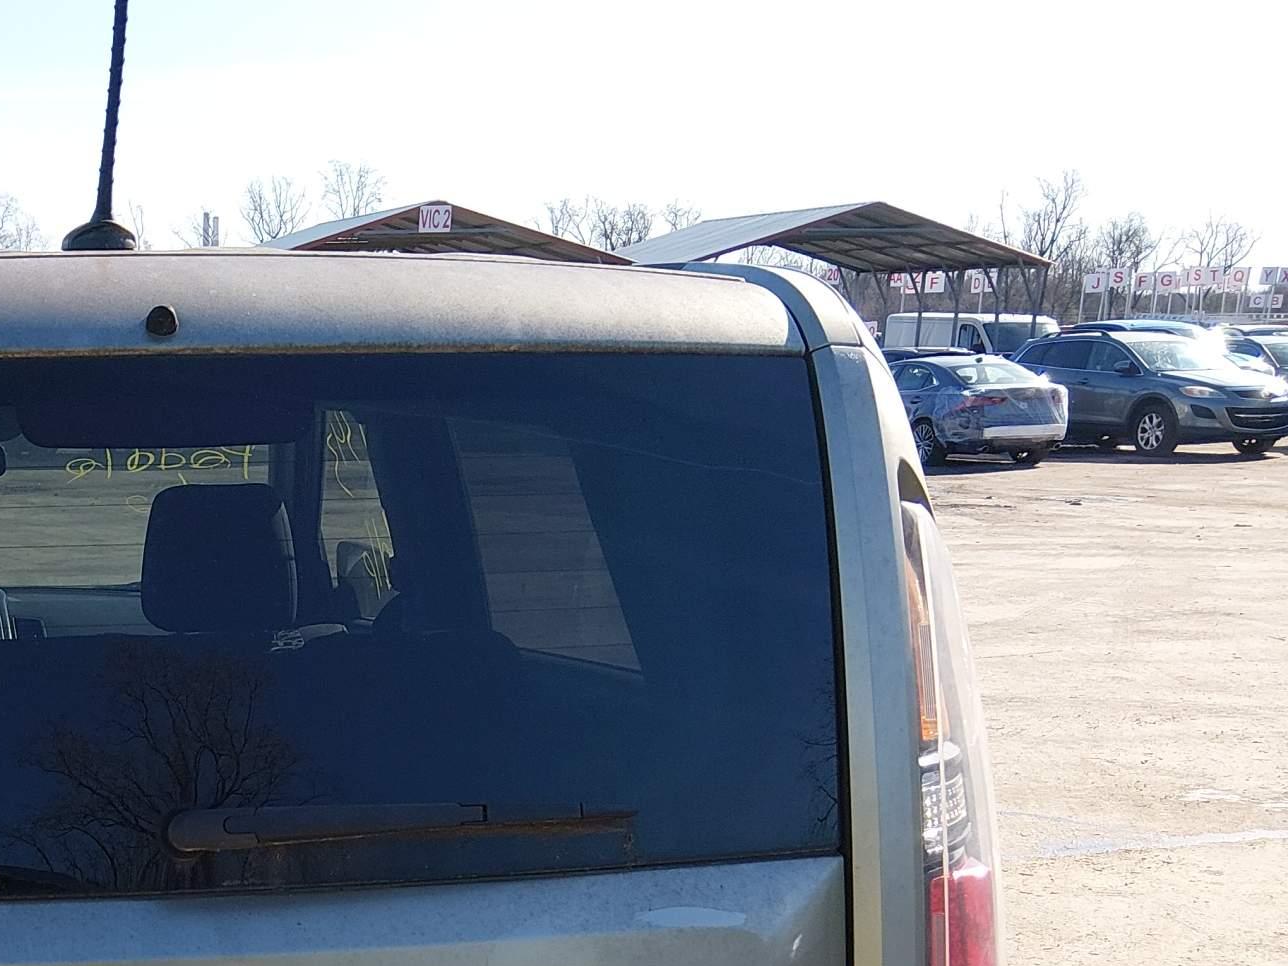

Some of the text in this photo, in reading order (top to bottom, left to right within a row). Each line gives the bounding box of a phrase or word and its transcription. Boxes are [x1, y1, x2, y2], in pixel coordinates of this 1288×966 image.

[421, 209, 451, 228] VIC 2
[827, 268, 839, 281] 20
[1113, 271, 1123, 284] S
[1160, 274, 1172, 287] G
[1193, 269, 1202, 281] S
[1210, 269, 1219, 282] T
[1234, 270, 1245, 283] Q
[1264, 270, 1273, 282] Y
[930, 277, 940, 290] F
[1092, 277, 1100, 289] J
[1138, 275, 1148, 288] F
[1253, 296, 1263, 306] C
